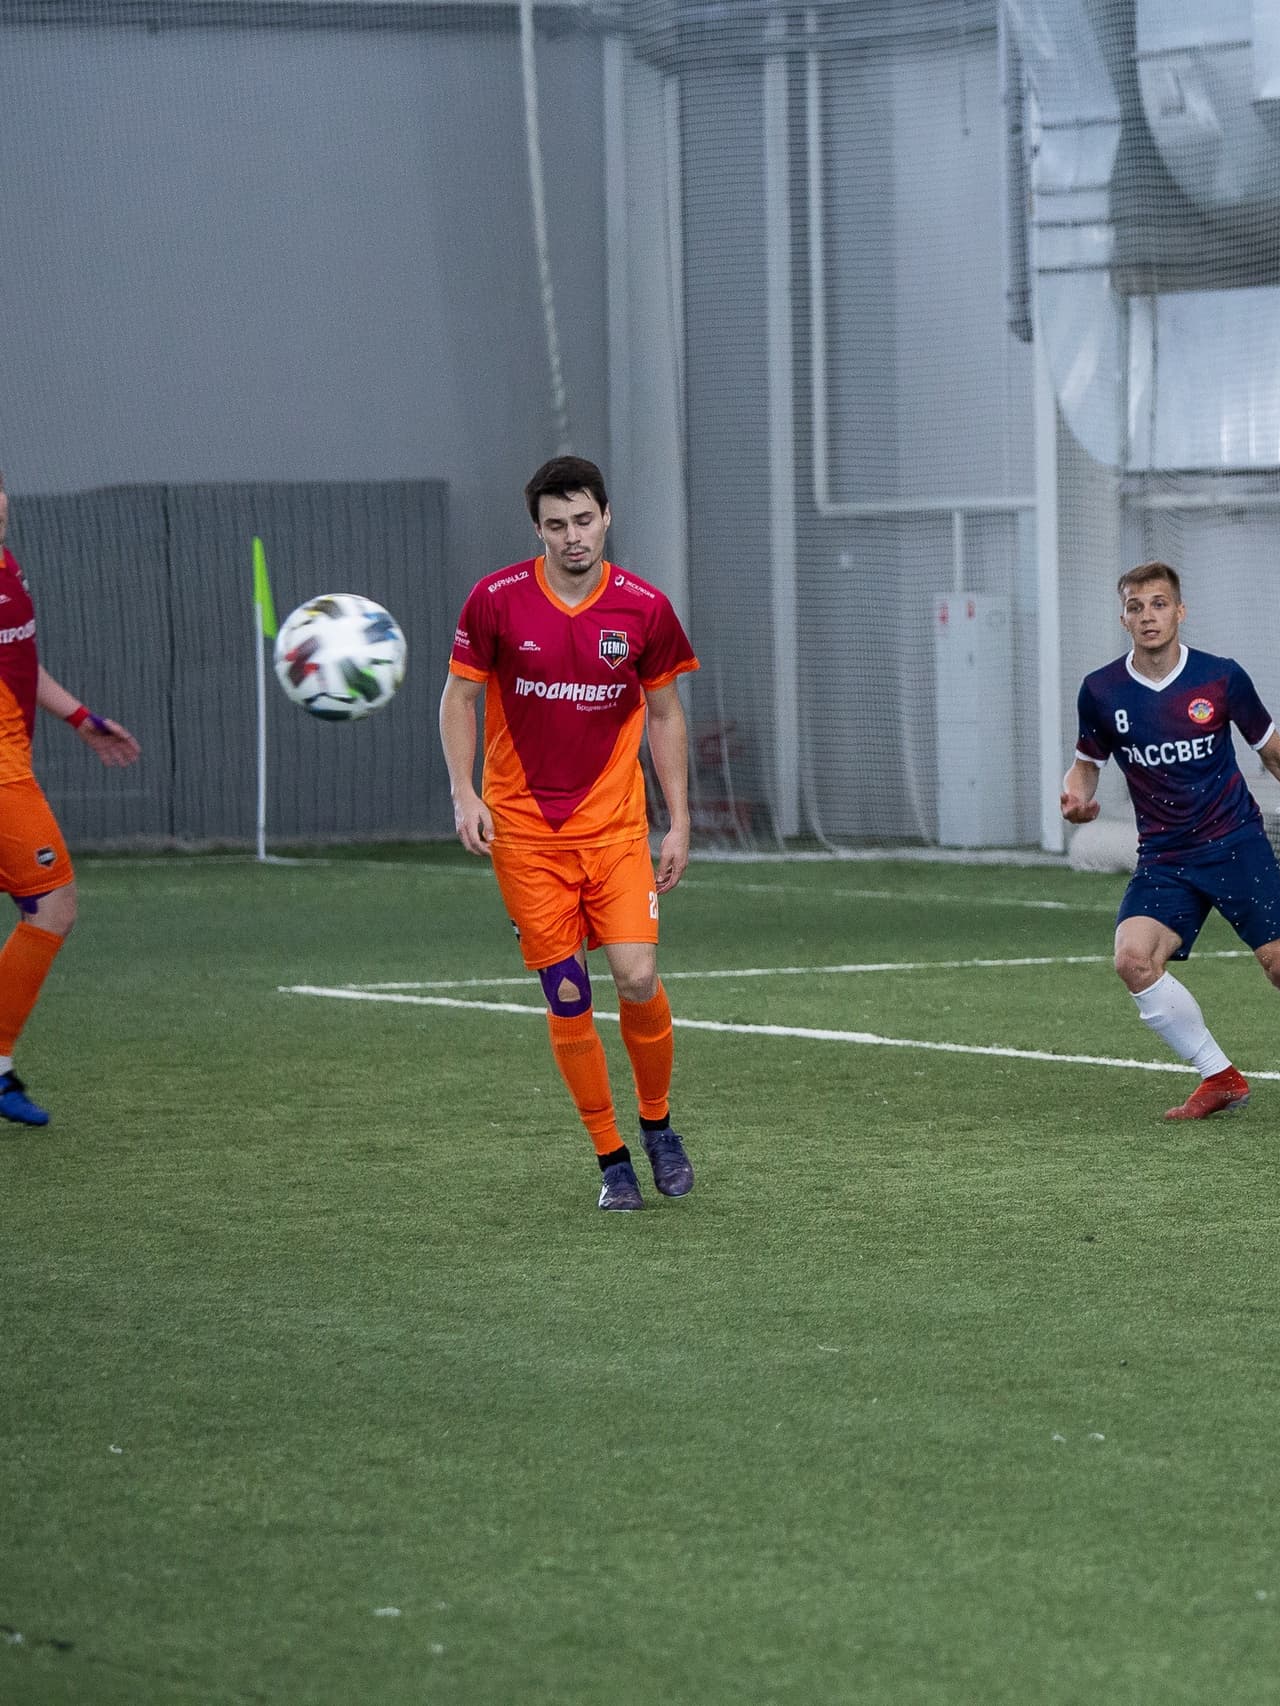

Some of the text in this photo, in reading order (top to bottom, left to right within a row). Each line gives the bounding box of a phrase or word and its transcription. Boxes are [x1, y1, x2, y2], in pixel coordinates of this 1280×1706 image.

[602, 640, 627, 656] ТЕМП
[515, 677, 627, 702] ПРОДИНВЕСТ
[1115, 709, 1130, 733] 8
[648, 890, 659, 920] 2
